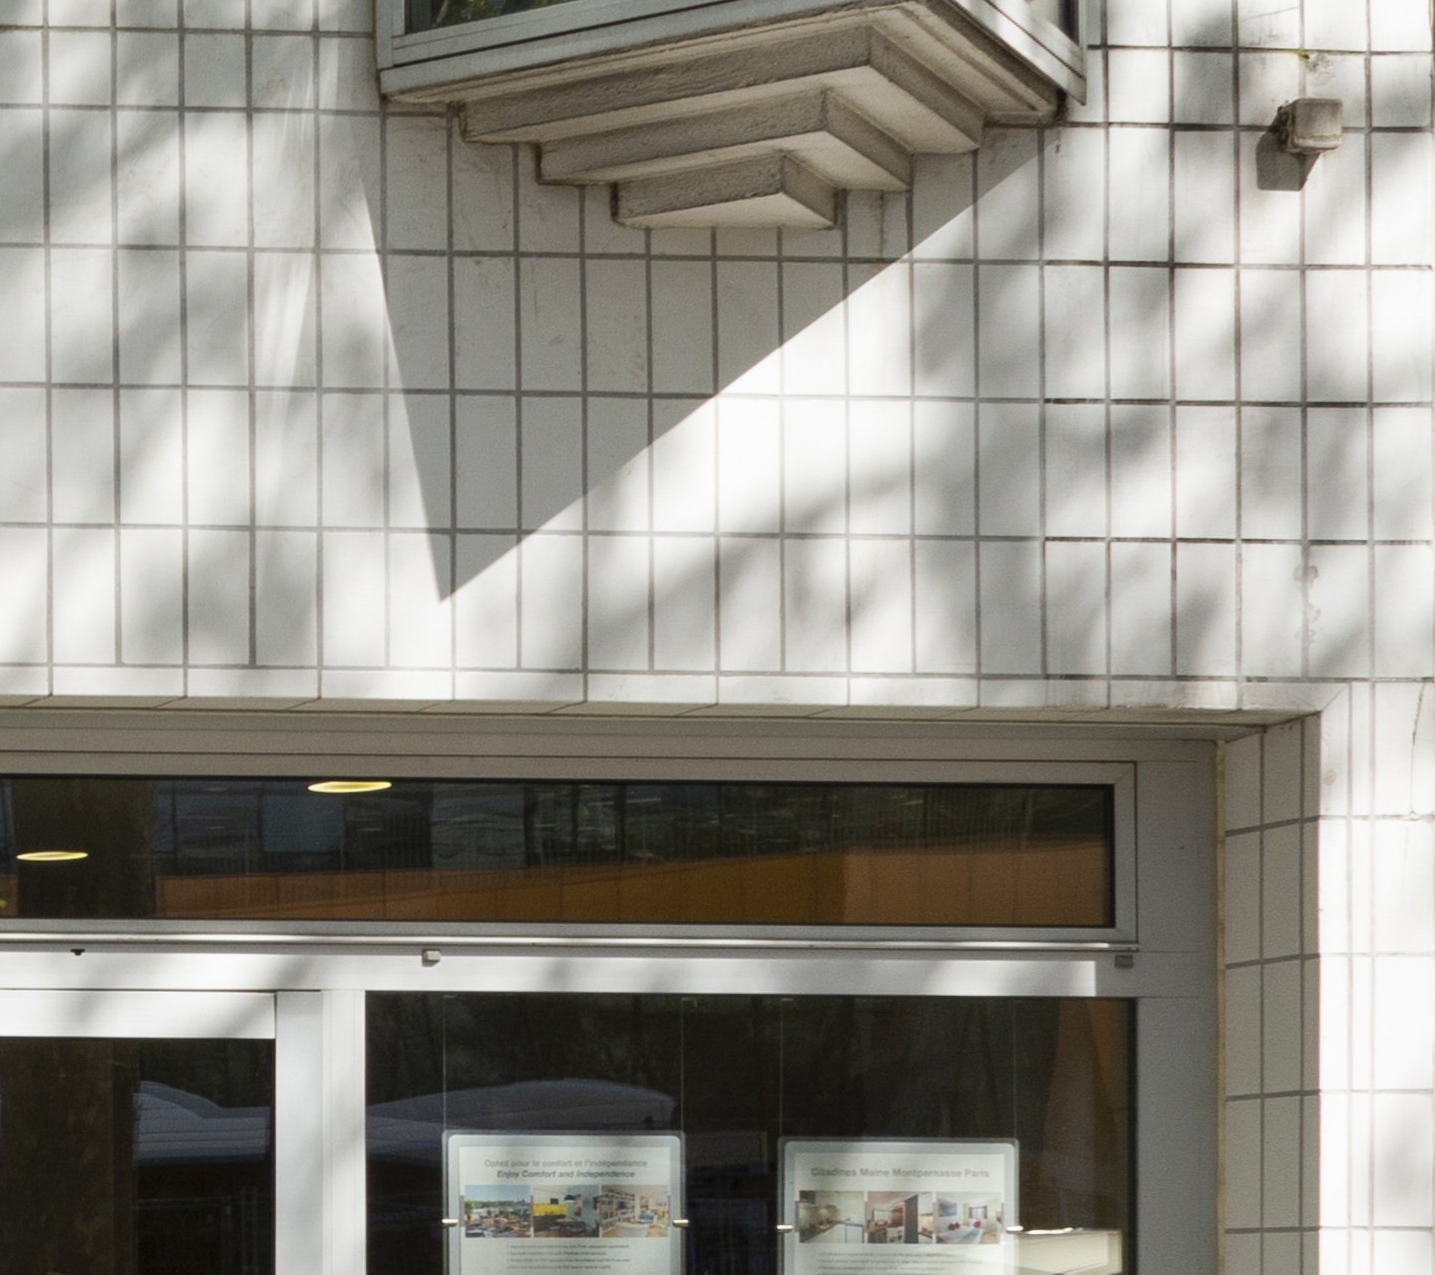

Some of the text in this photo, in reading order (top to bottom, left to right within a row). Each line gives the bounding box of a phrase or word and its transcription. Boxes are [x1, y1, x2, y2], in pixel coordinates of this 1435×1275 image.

[811, 1168, 989, 1180] Citadines Maine Montparnasse Paris
